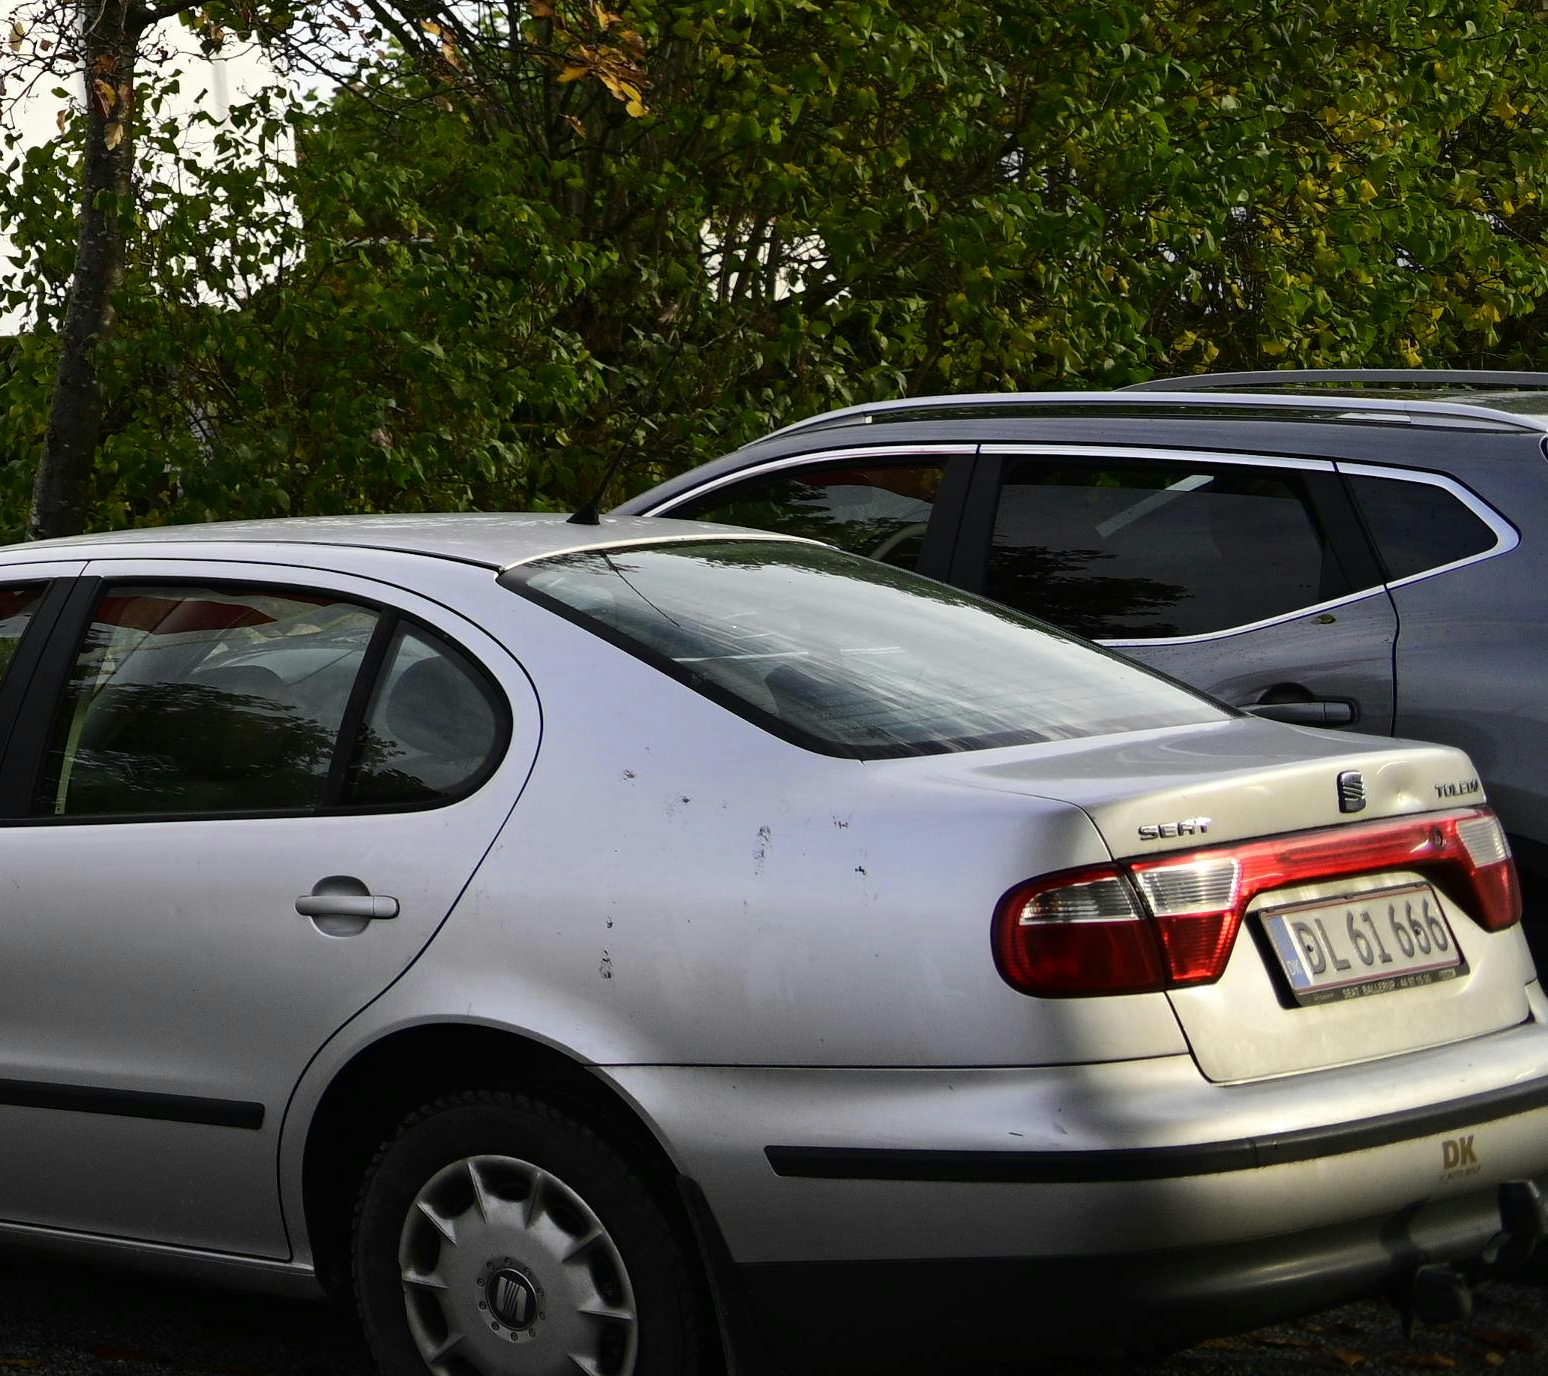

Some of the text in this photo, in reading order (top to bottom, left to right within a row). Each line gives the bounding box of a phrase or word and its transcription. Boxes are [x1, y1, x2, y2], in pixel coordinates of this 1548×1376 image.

[1138, 816, 1212, 841] SEAT
[1291, 896, 1448, 975] DL 61 666
[1286, 959, 1304, 977] DK
[1442, 1134, 1477, 1169] DK
